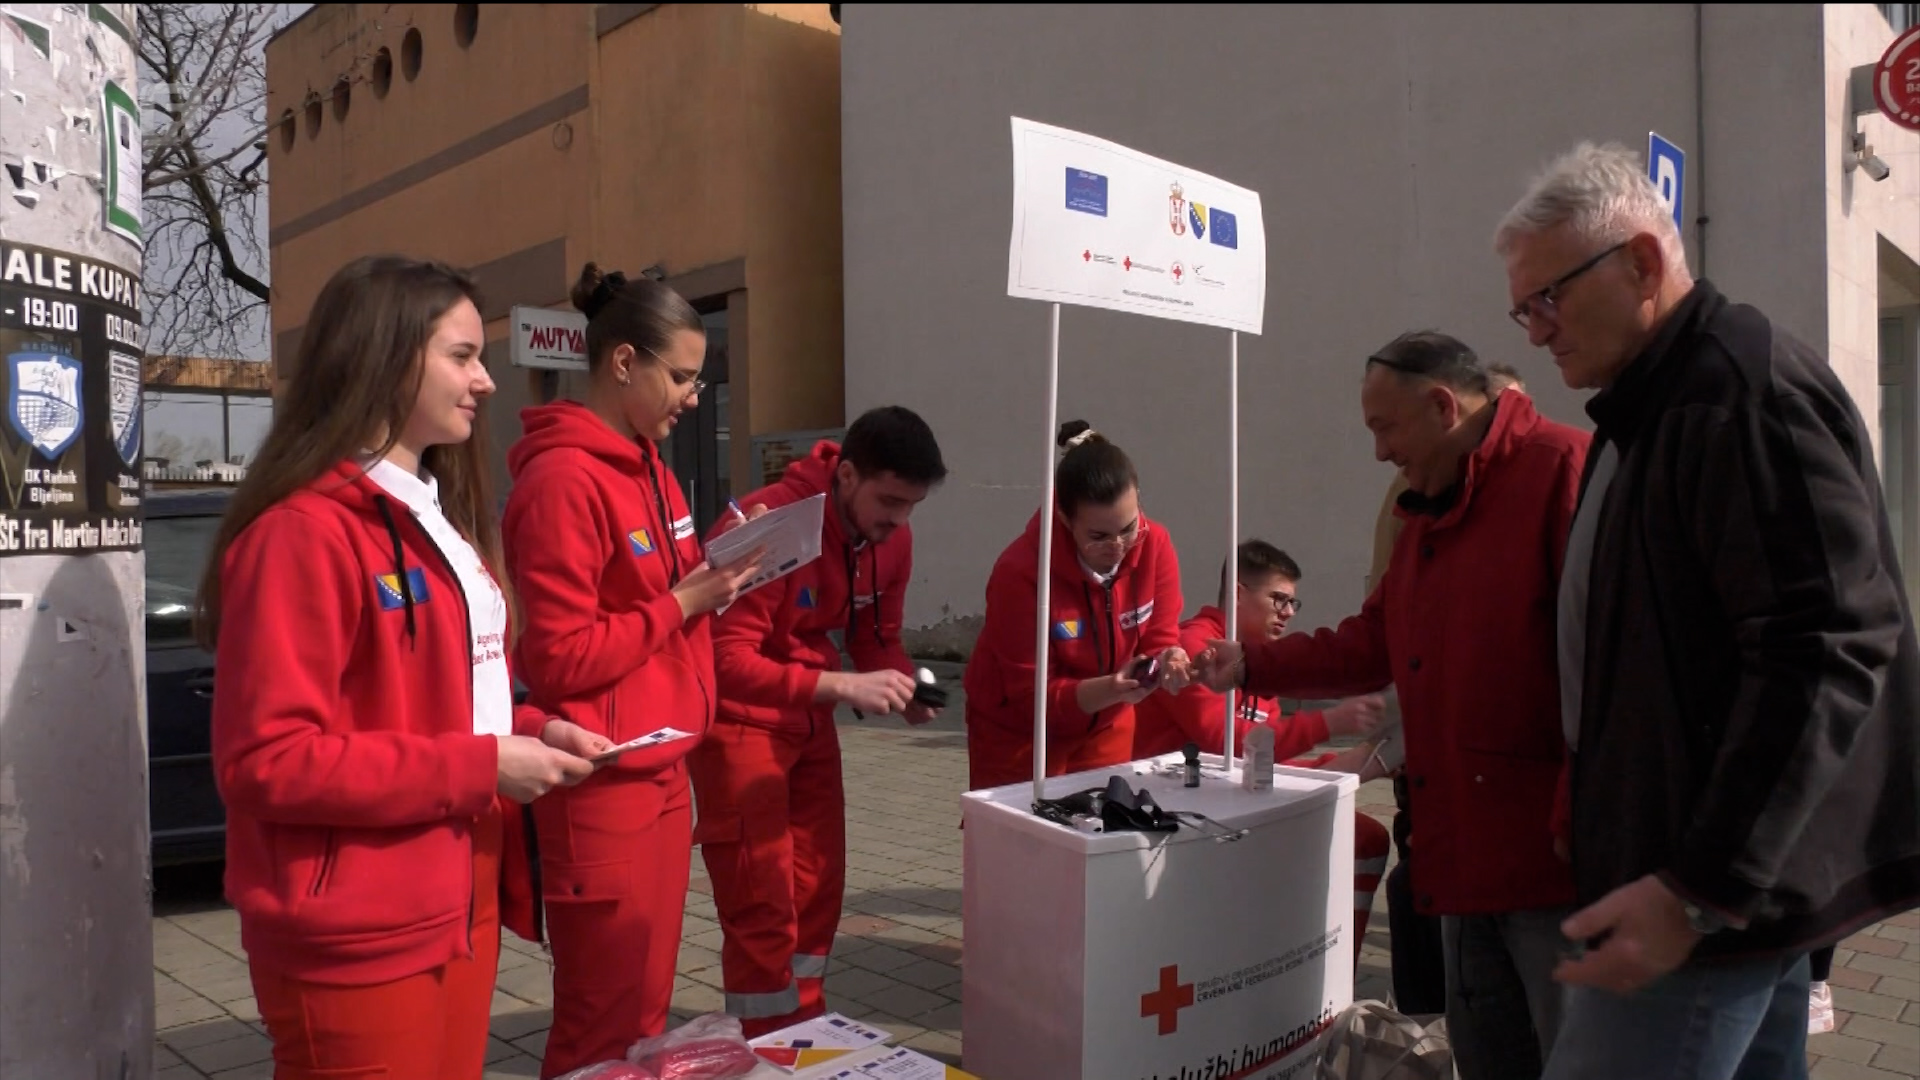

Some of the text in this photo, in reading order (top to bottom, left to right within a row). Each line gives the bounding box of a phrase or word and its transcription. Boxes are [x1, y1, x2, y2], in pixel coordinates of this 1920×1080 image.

[0, 249, 73, 291] ALE
[80, 262, 133, 308] KUPA
[23, 297, 78, 332] 19:00
[24, 519, 49, 550] fra
[1166, 1049, 1237, 1080] lužbi
[1241, 999, 1333, 1072] humanosti
